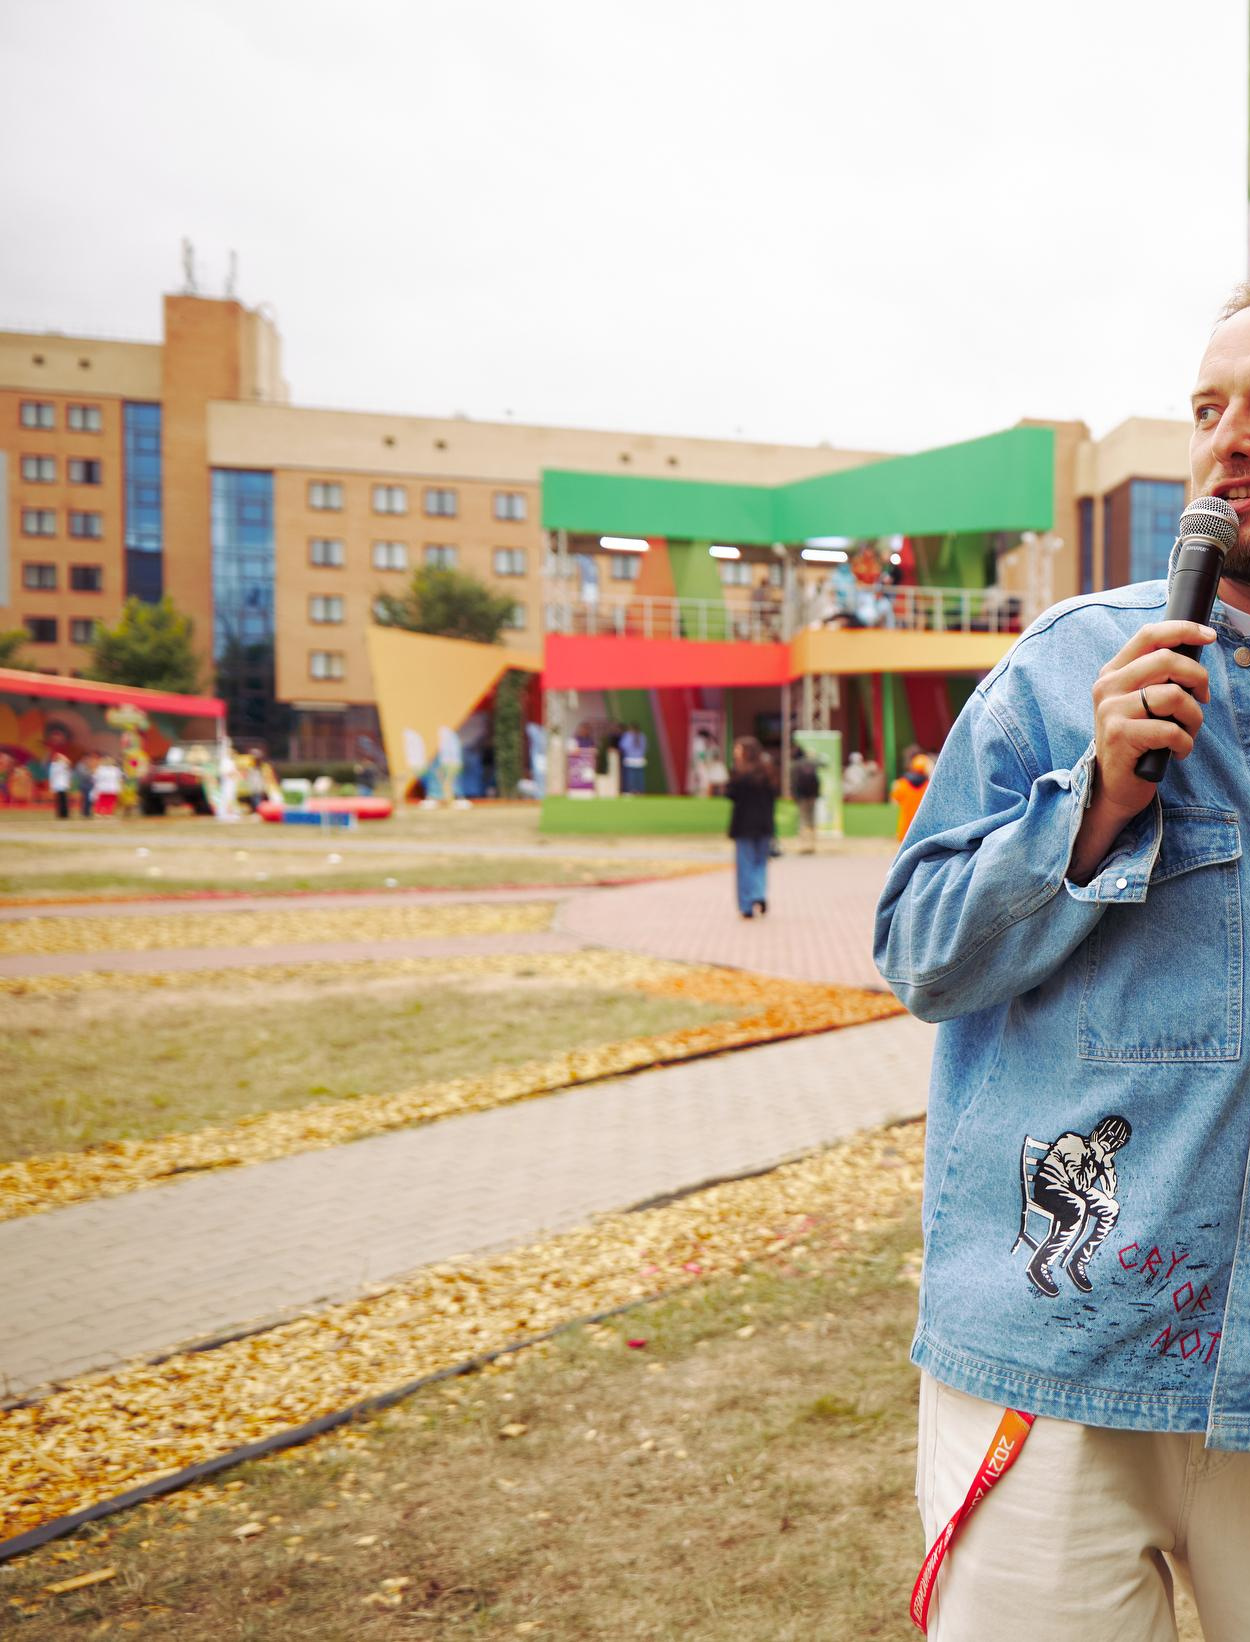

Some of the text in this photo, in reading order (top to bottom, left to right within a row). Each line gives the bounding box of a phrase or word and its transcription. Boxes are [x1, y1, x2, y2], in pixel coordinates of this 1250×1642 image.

[1117, 1242, 1190, 1279] CRY
[1172, 1281, 1213, 1312] OR
[1151, 1323, 1223, 1364] NOT
